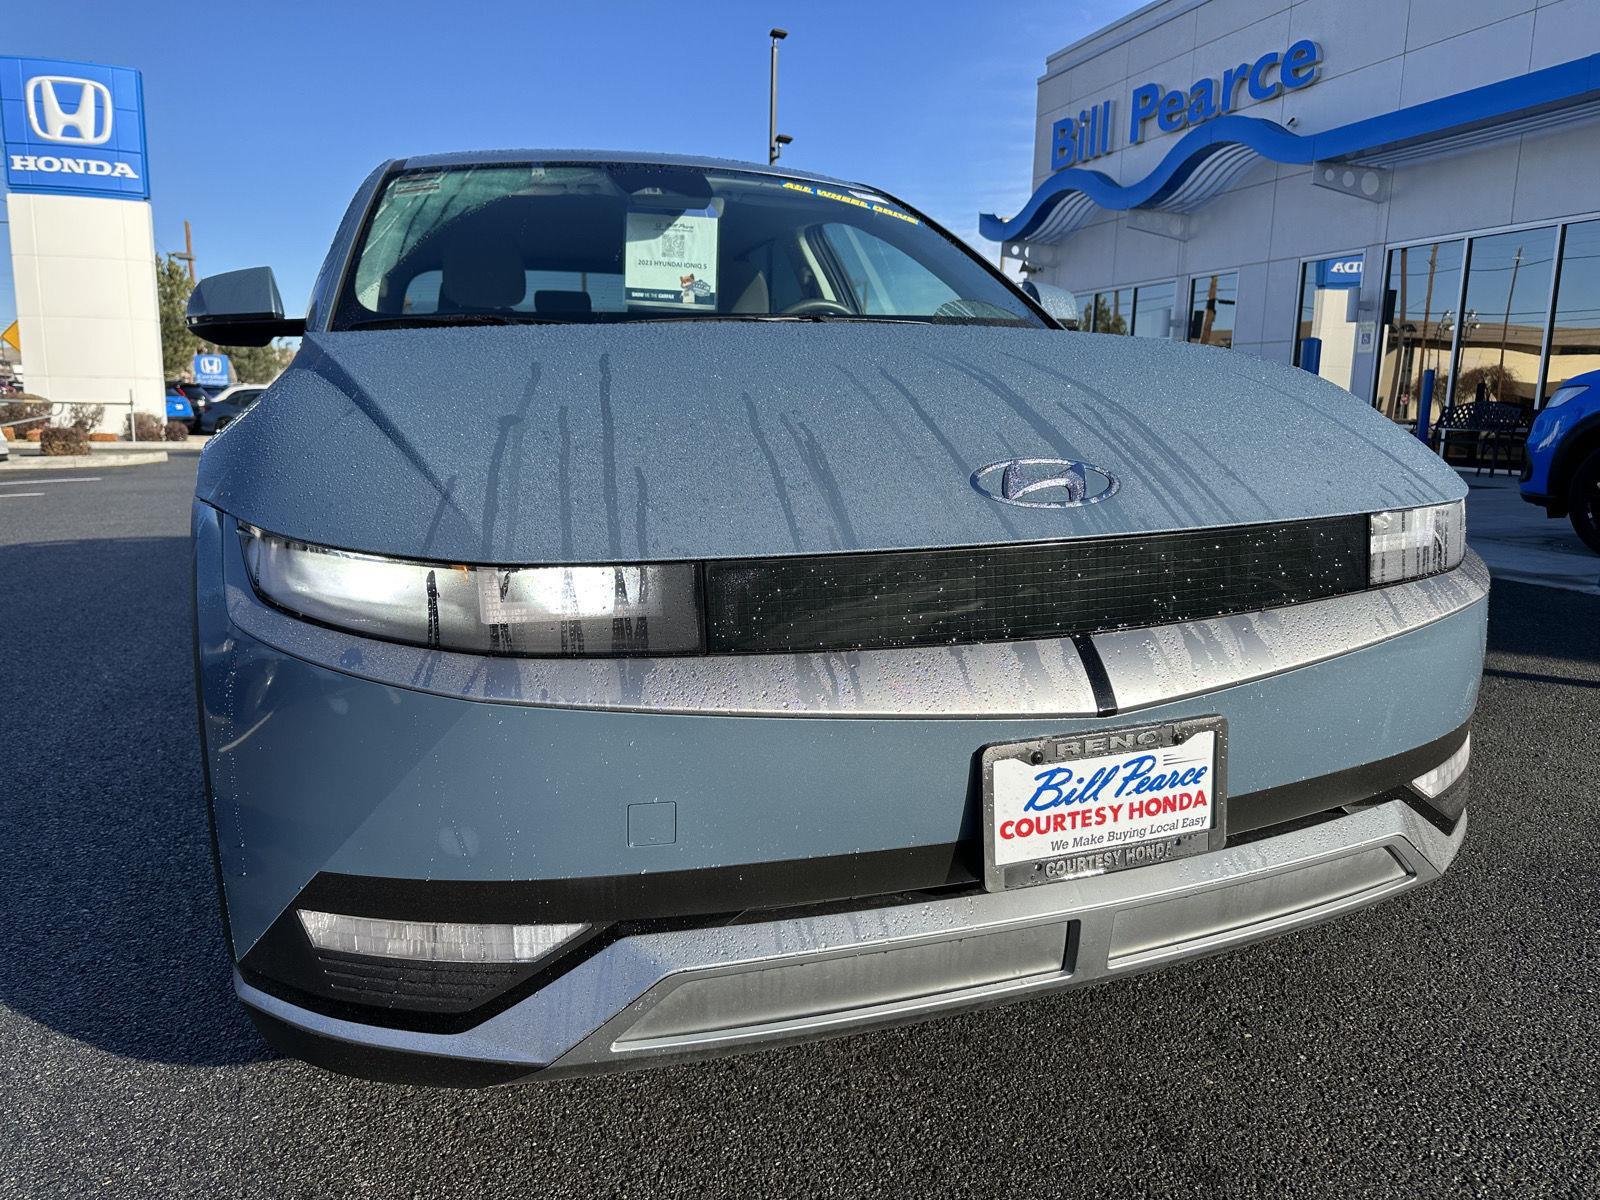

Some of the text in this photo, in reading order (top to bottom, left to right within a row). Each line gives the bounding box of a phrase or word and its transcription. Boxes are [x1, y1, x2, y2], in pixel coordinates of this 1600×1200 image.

[1051, 39, 1321, 171] Bill Pearce
[10, 155, 139, 178] HONDA
[782, 182, 815, 194] ALL
[816, 189, 872, 209] WHEEL
[653, 260, 683, 268] HYUNDAI
[683, 262, 703, 270] IONIQ
[1055, 731, 1157, 758] RENO
[1023, 754, 1208, 812] Bill Pearce
[999, 789, 1208, 840] COURTESY HONDA
[1050, 815, 1207, 852] We Make Buying Local Easy
[1044, 839, 1174, 878] COURTESY HONDA
